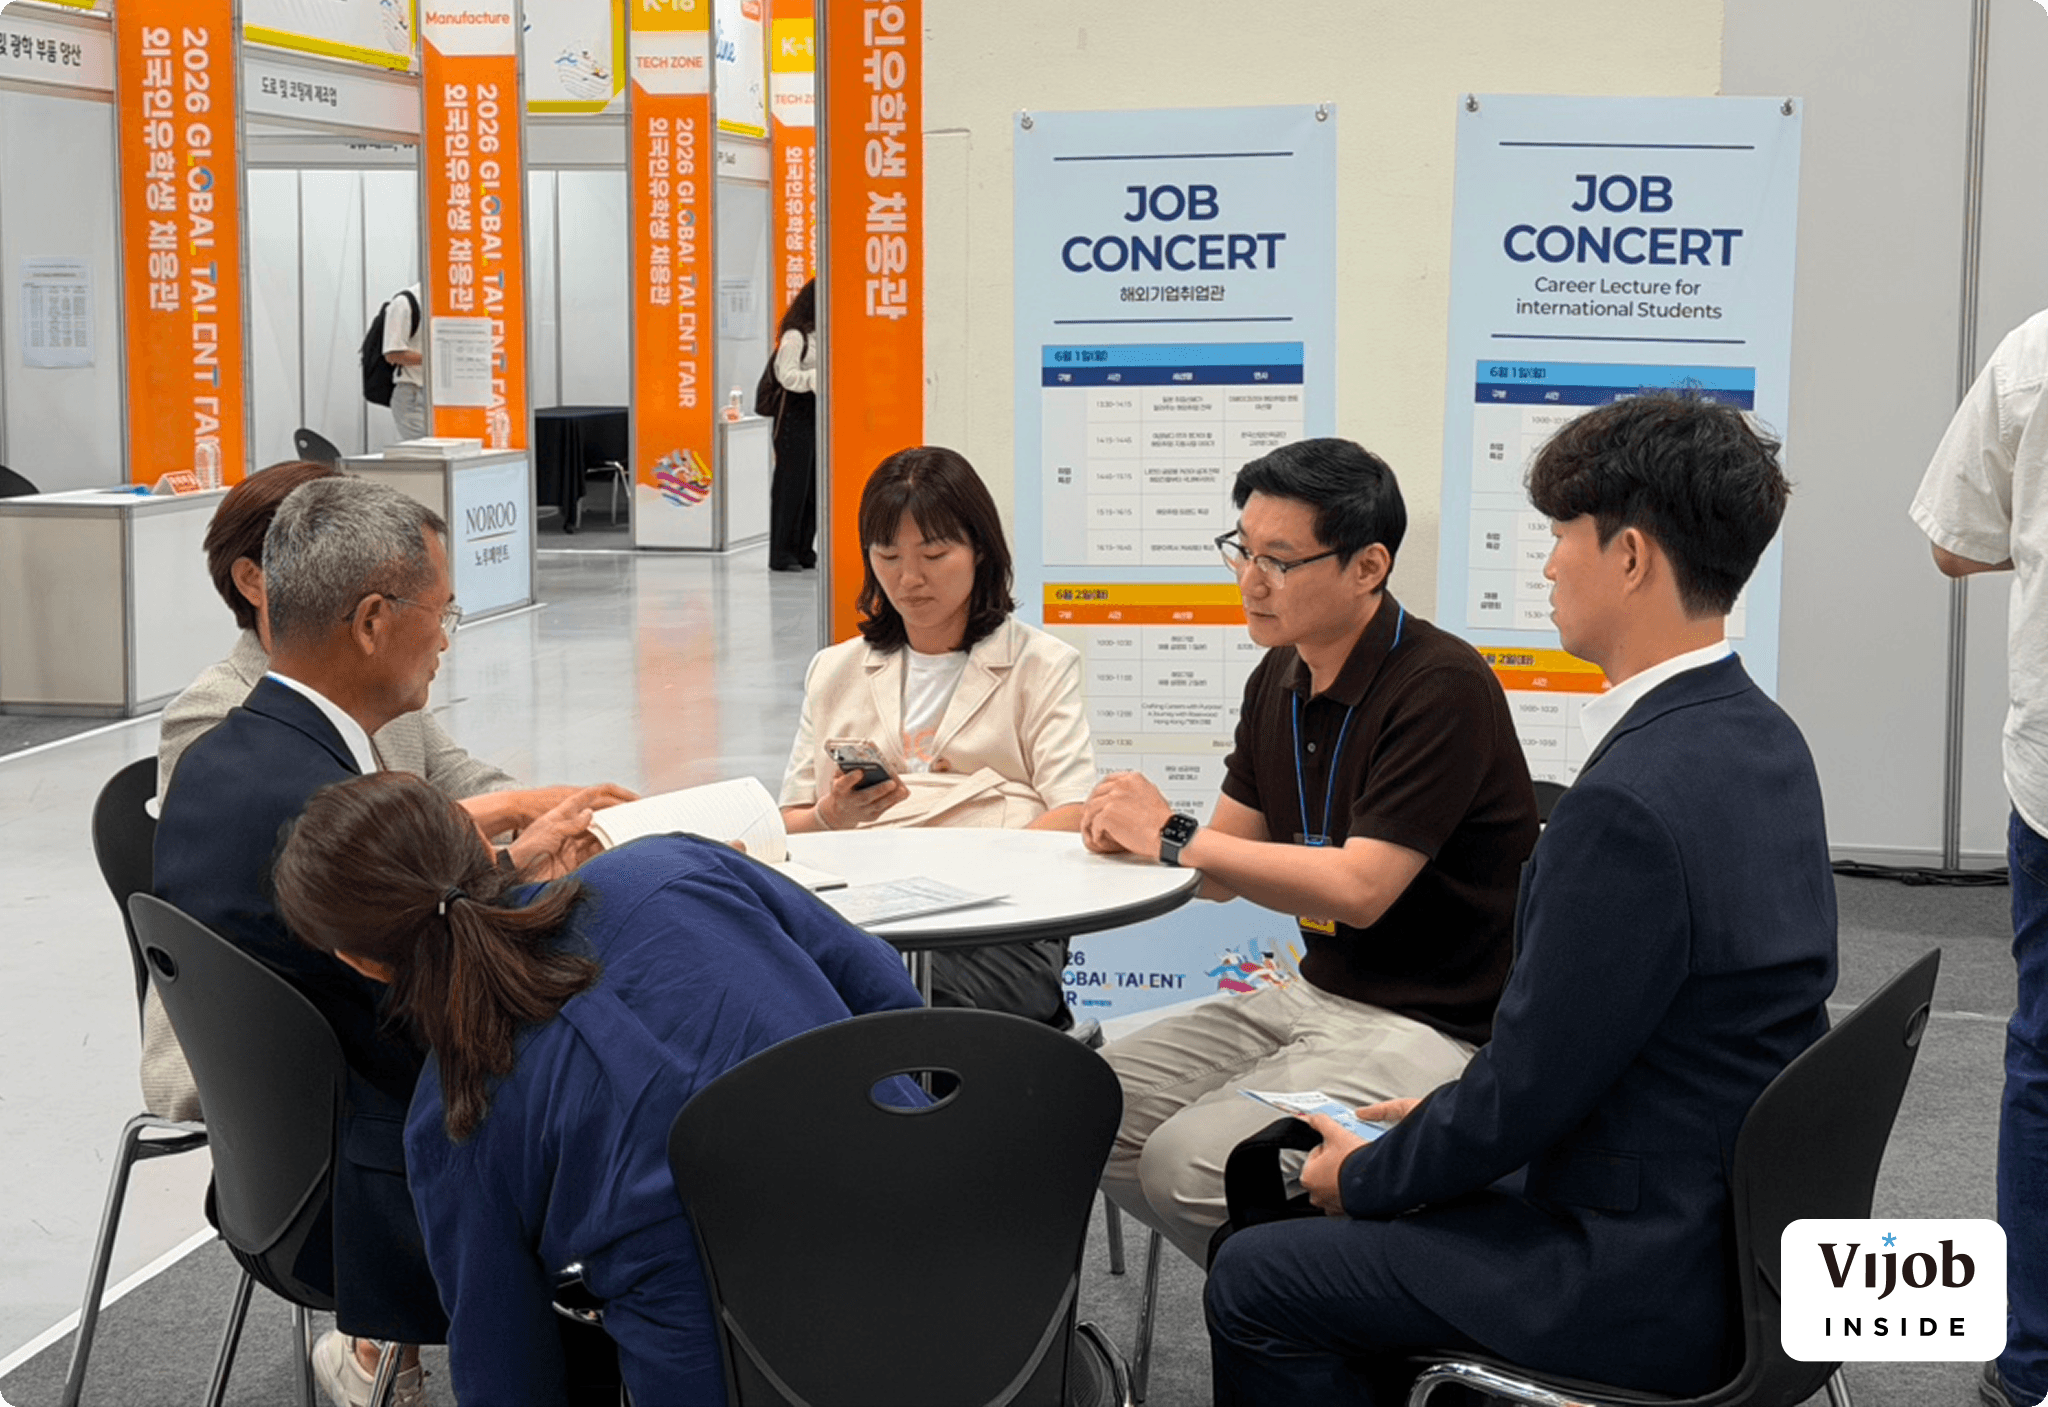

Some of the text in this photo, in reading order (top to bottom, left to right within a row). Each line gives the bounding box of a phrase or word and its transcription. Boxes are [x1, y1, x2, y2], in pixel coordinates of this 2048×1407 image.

[426, 11, 510, 25] Manufacture
[10, 34, 33, 60] 광학
[36, 39, 57, 63] 부품
[60, 42, 82, 67] 양산
[635, 56, 703, 69] TECH ZONE
[781, 36, 814, 57] K-1
[182, 26, 211, 113] 2026
[477, 83, 499, 153] 2026
[774, 94, 816, 105] TECH ZO
[142, 26, 180, 312] 외국인유학생 채용관
[444, 83, 472, 231] 외국인유학생
[863, 0, 908, 321] 인유학생 채용관
[185, 122, 214, 256] GLOBAL
[785, 145, 805, 251] 외국인유학생
[1124, 184, 1219, 223] JOB
[1571, 174, 1673, 213] JOB
[478, 160, 502, 266] GLOBAL
[648, 117, 671, 306] 외국인유학생 채용관
[675, 117, 698, 409] 2026 GLOBAL TALENT FAIR
[1061, 232, 1287, 273] CONCERT
[1503, 224, 1743, 266] CONCERT
[448, 238, 475, 312] 채용관
[1119, 285, 1225, 302] 해외기업취업관
[1534, 276, 1701, 296] Career Lecture for
[190, 261, 220, 388] TALENT
[1637, 302, 1722, 319] Students
[466, 500, 517, 535] NOROO
[1067, 951, 1086, 967] 26
[1062, 970, 1187, 990] OBAL TALENT
